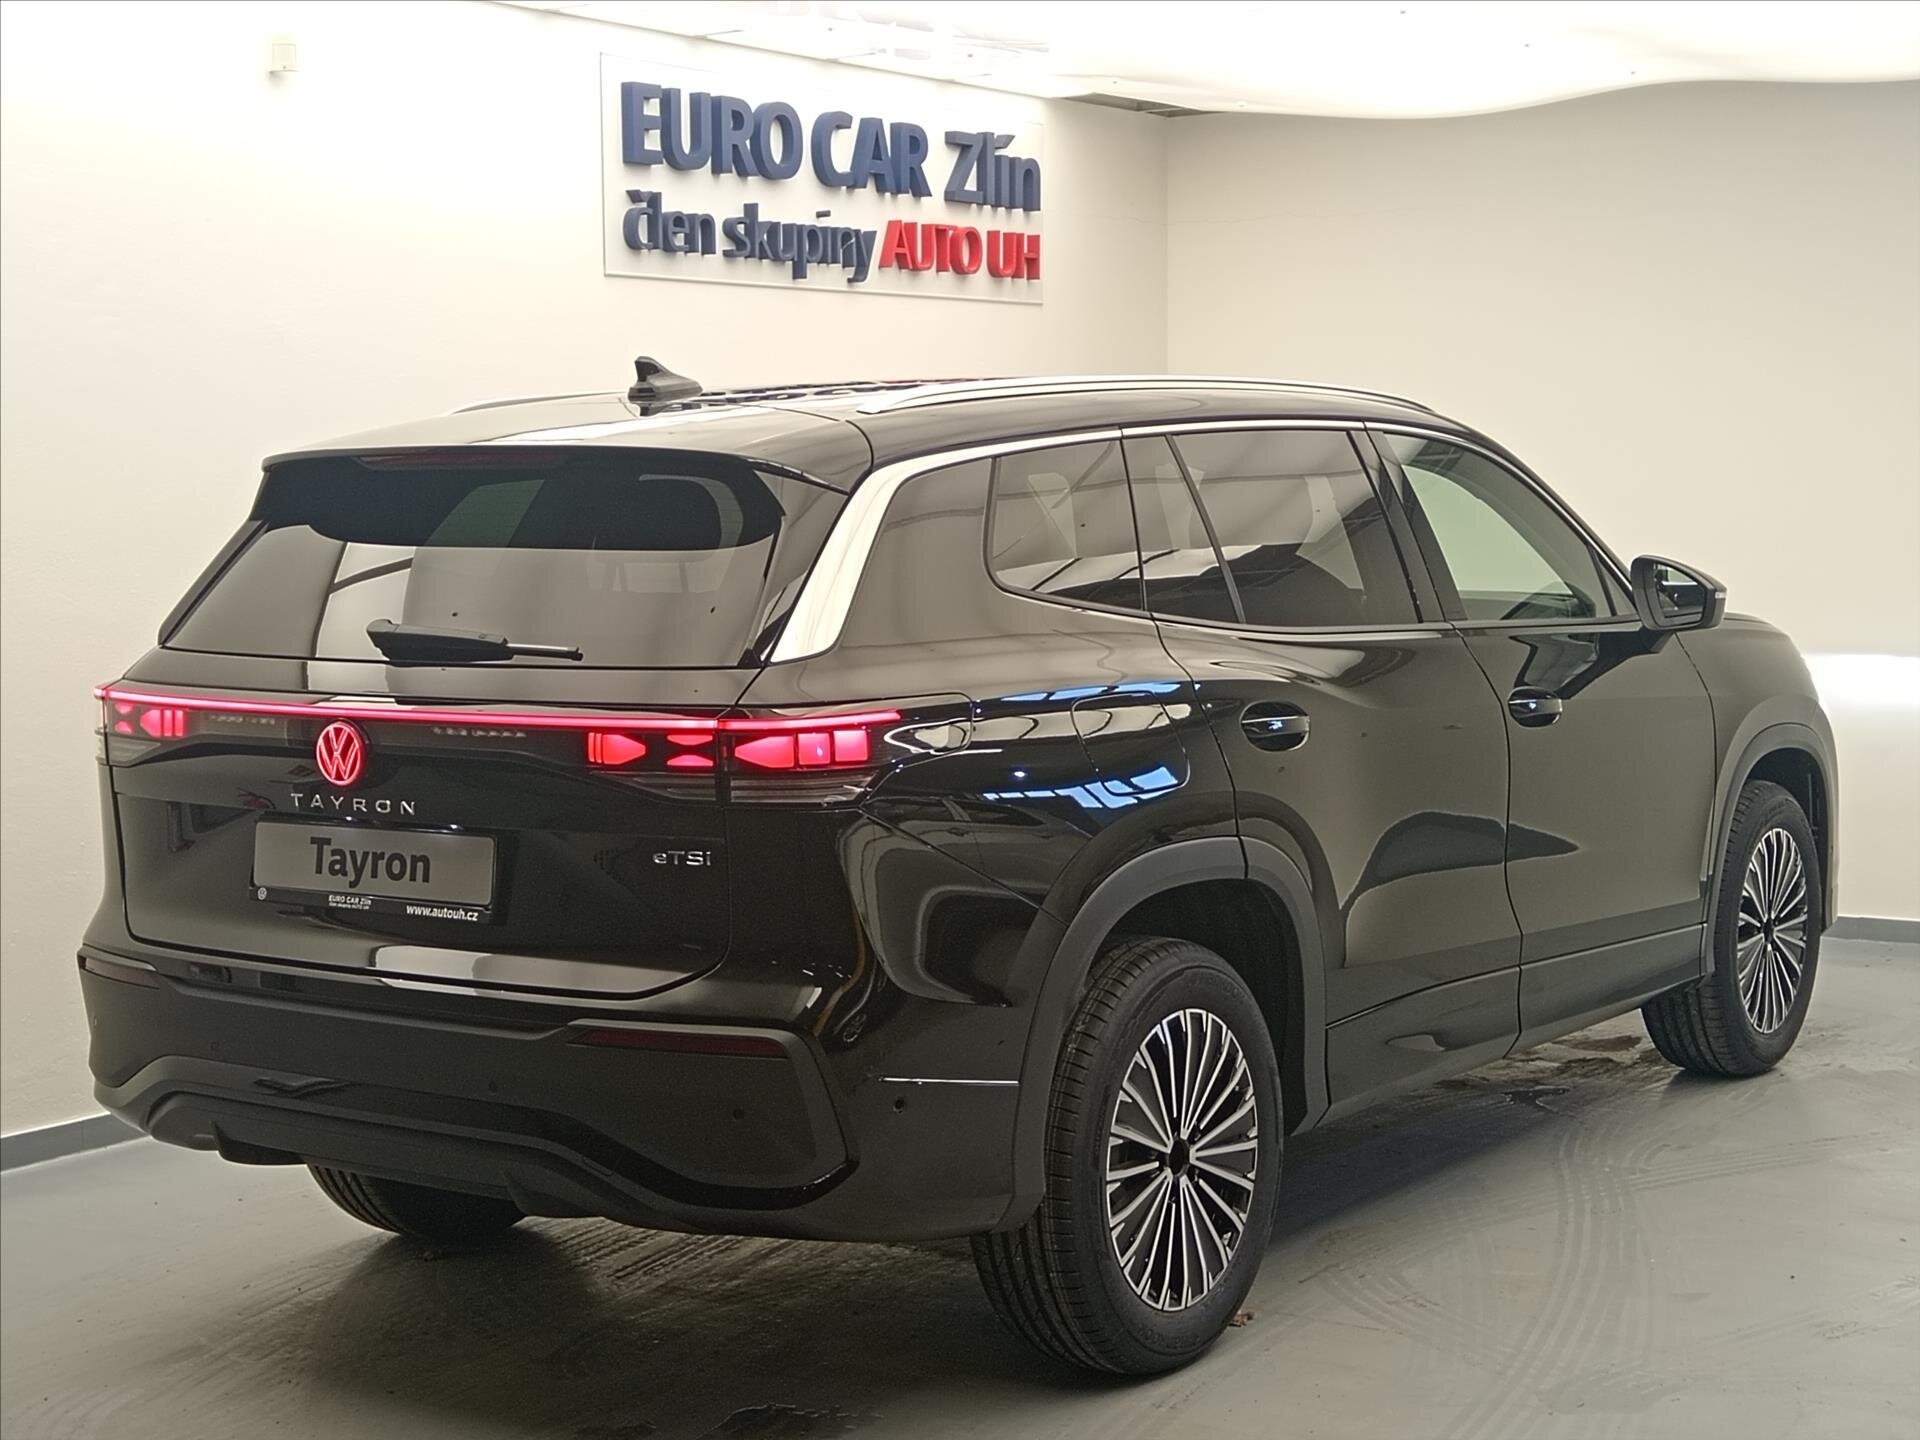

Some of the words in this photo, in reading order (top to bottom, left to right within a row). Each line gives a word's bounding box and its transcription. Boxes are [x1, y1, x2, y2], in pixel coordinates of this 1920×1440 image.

[621, 81, 803, 180] EURO
[810, 111, 932, 197] CAR
[944, 131, 1041, 211] Zlín
[623, 189, 716, 255] člen
[722, 202, 877, 283] skupiny
[878, 219, 982, 275] AUTO
[987, 230, 1040, 280] UH
[290, 793, 416, 815] TAYRON
[310, 836, 431, 888] Tayron
[406, 904, 479, 921] www.autouh.cz
